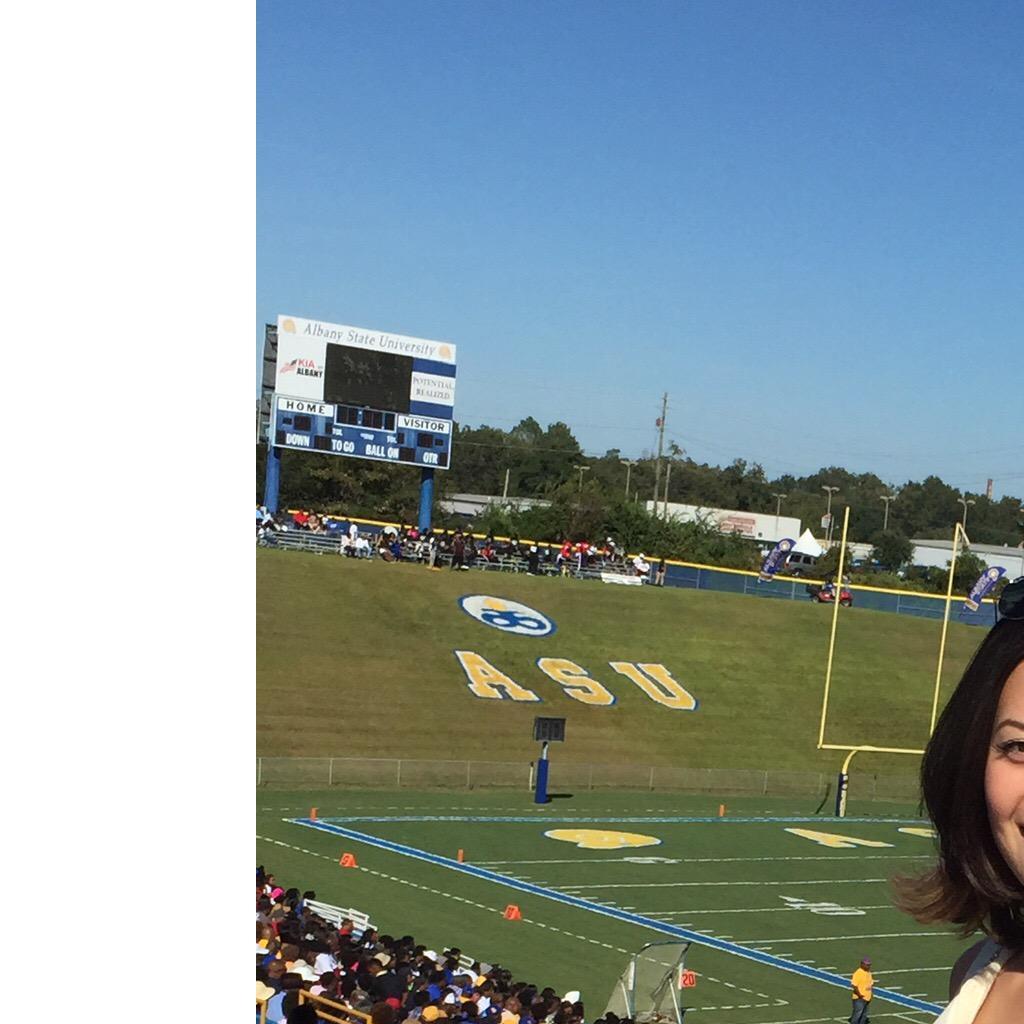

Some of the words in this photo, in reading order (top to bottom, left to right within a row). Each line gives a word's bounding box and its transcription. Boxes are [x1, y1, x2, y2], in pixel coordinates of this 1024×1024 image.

[304, 323, 343, 340] Albany
[347, 329, 376, 345] State
[379, 335, 437, 357] University
[297, 358, 315, 369] KIA
[296, 367, 323, 379] ALBANY
[412, 376, 453, 391] POTENTIAL
[286, 400, 326, 415] HOME
[403, 418, 445, 432] VISITOR
[285, 433, 310, 447] DOWN
[332, 439, 344, 451] TO
[343, 441, 355, 453] GO
[365, 444, 386, 457] BALL
[386, 447, 399, 459] ON
[682, 973, 695, 986] 20
